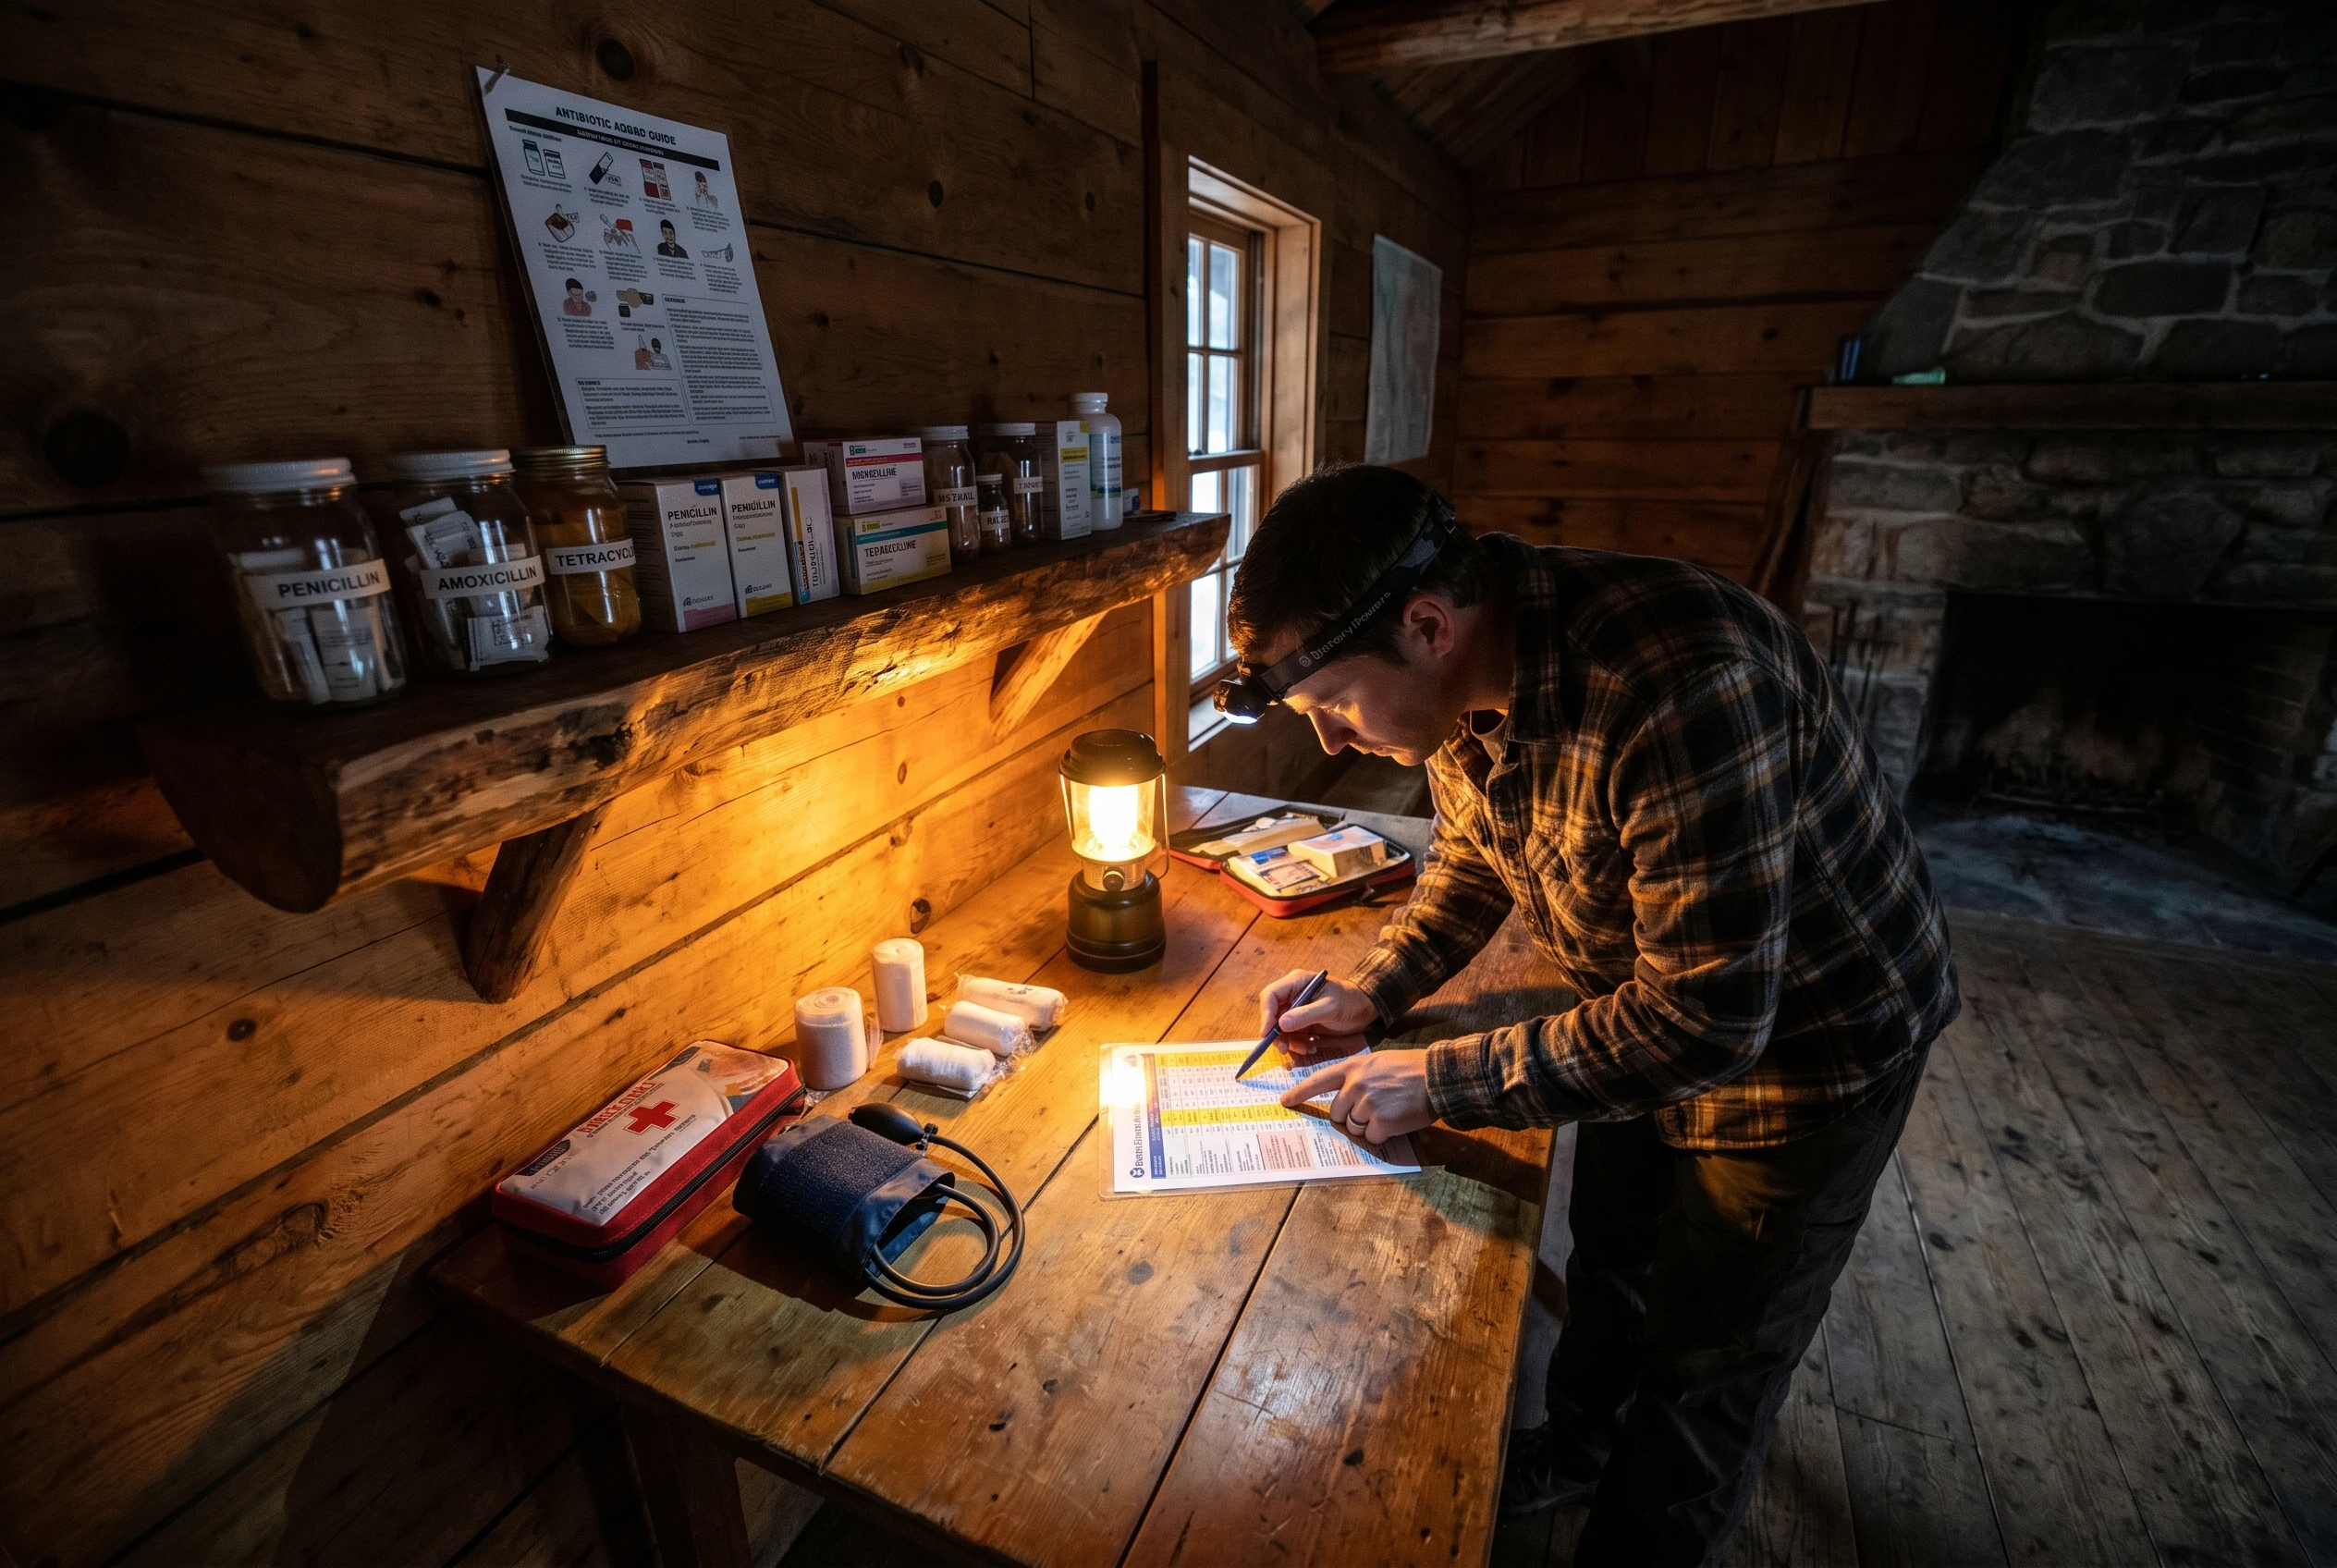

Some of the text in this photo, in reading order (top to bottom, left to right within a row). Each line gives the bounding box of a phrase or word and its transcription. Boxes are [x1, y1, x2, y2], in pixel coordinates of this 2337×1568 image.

[556, 106, 612, 129] ANTIBIOTIC
[648, 130, 677, 146] GUIDE
[277, 570, 381, 599] PENICILLIN
[438, 565, 537, 591] AMOXICILLIN
